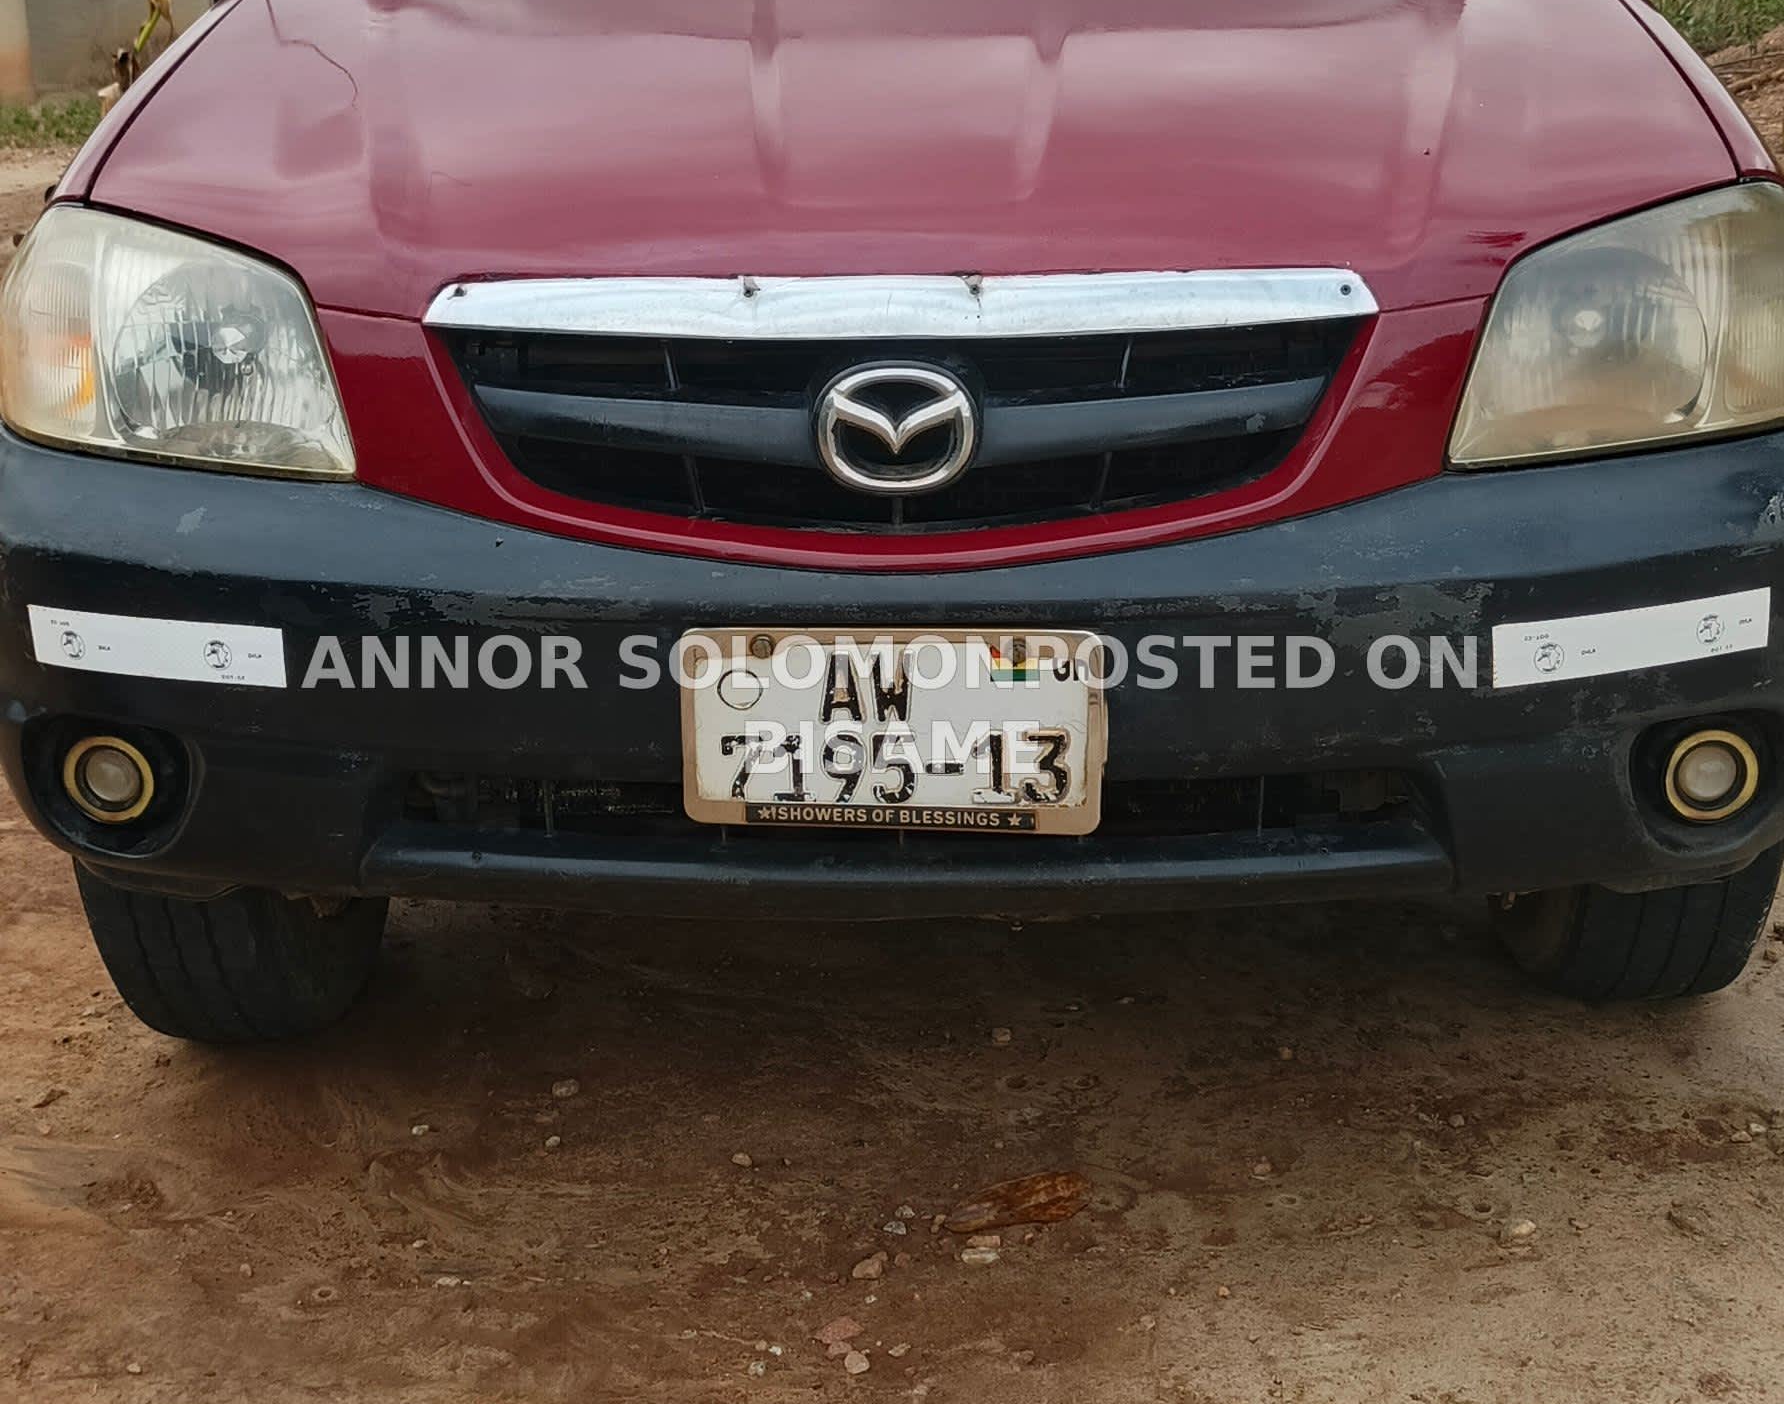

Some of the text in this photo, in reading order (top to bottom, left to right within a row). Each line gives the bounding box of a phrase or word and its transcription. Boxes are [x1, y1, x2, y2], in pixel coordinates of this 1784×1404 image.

[821, 651, 917, 723] AW
[720, 730, 1072, 804] 7195-13
[777, 805, 1001, 827] SHOWERS OF BLESSINGS
